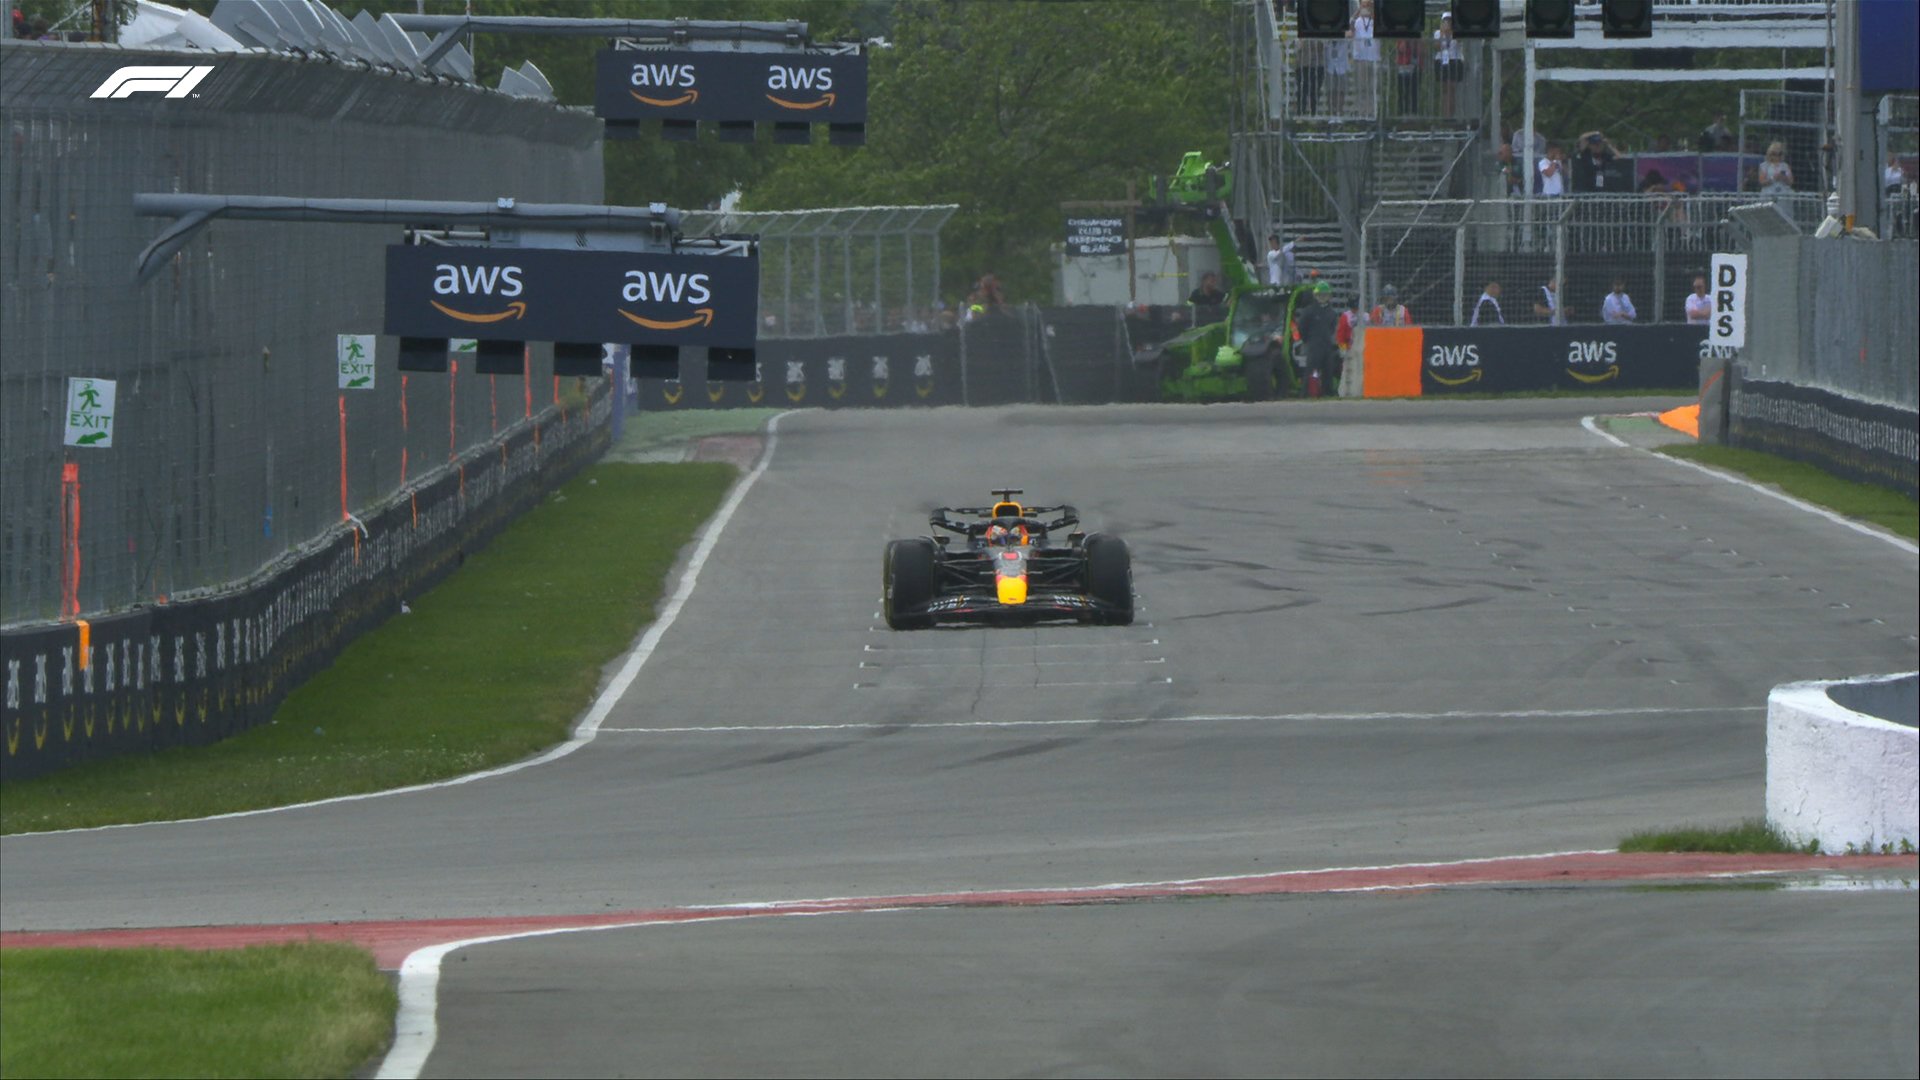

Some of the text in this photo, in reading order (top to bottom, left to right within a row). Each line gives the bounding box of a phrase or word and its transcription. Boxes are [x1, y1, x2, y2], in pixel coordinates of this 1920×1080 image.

[631, 63, 833, 91] aws aws
[433, 263, 711, 305] aws aws
[1717, 263, 1737, 337] DRS
[1430, 344, 1480, 367] aws
[1568, 341, 1617, 363] aws
[340, 363, 374, 375] EXIT
[70, 413, 112, 429] EXIT
